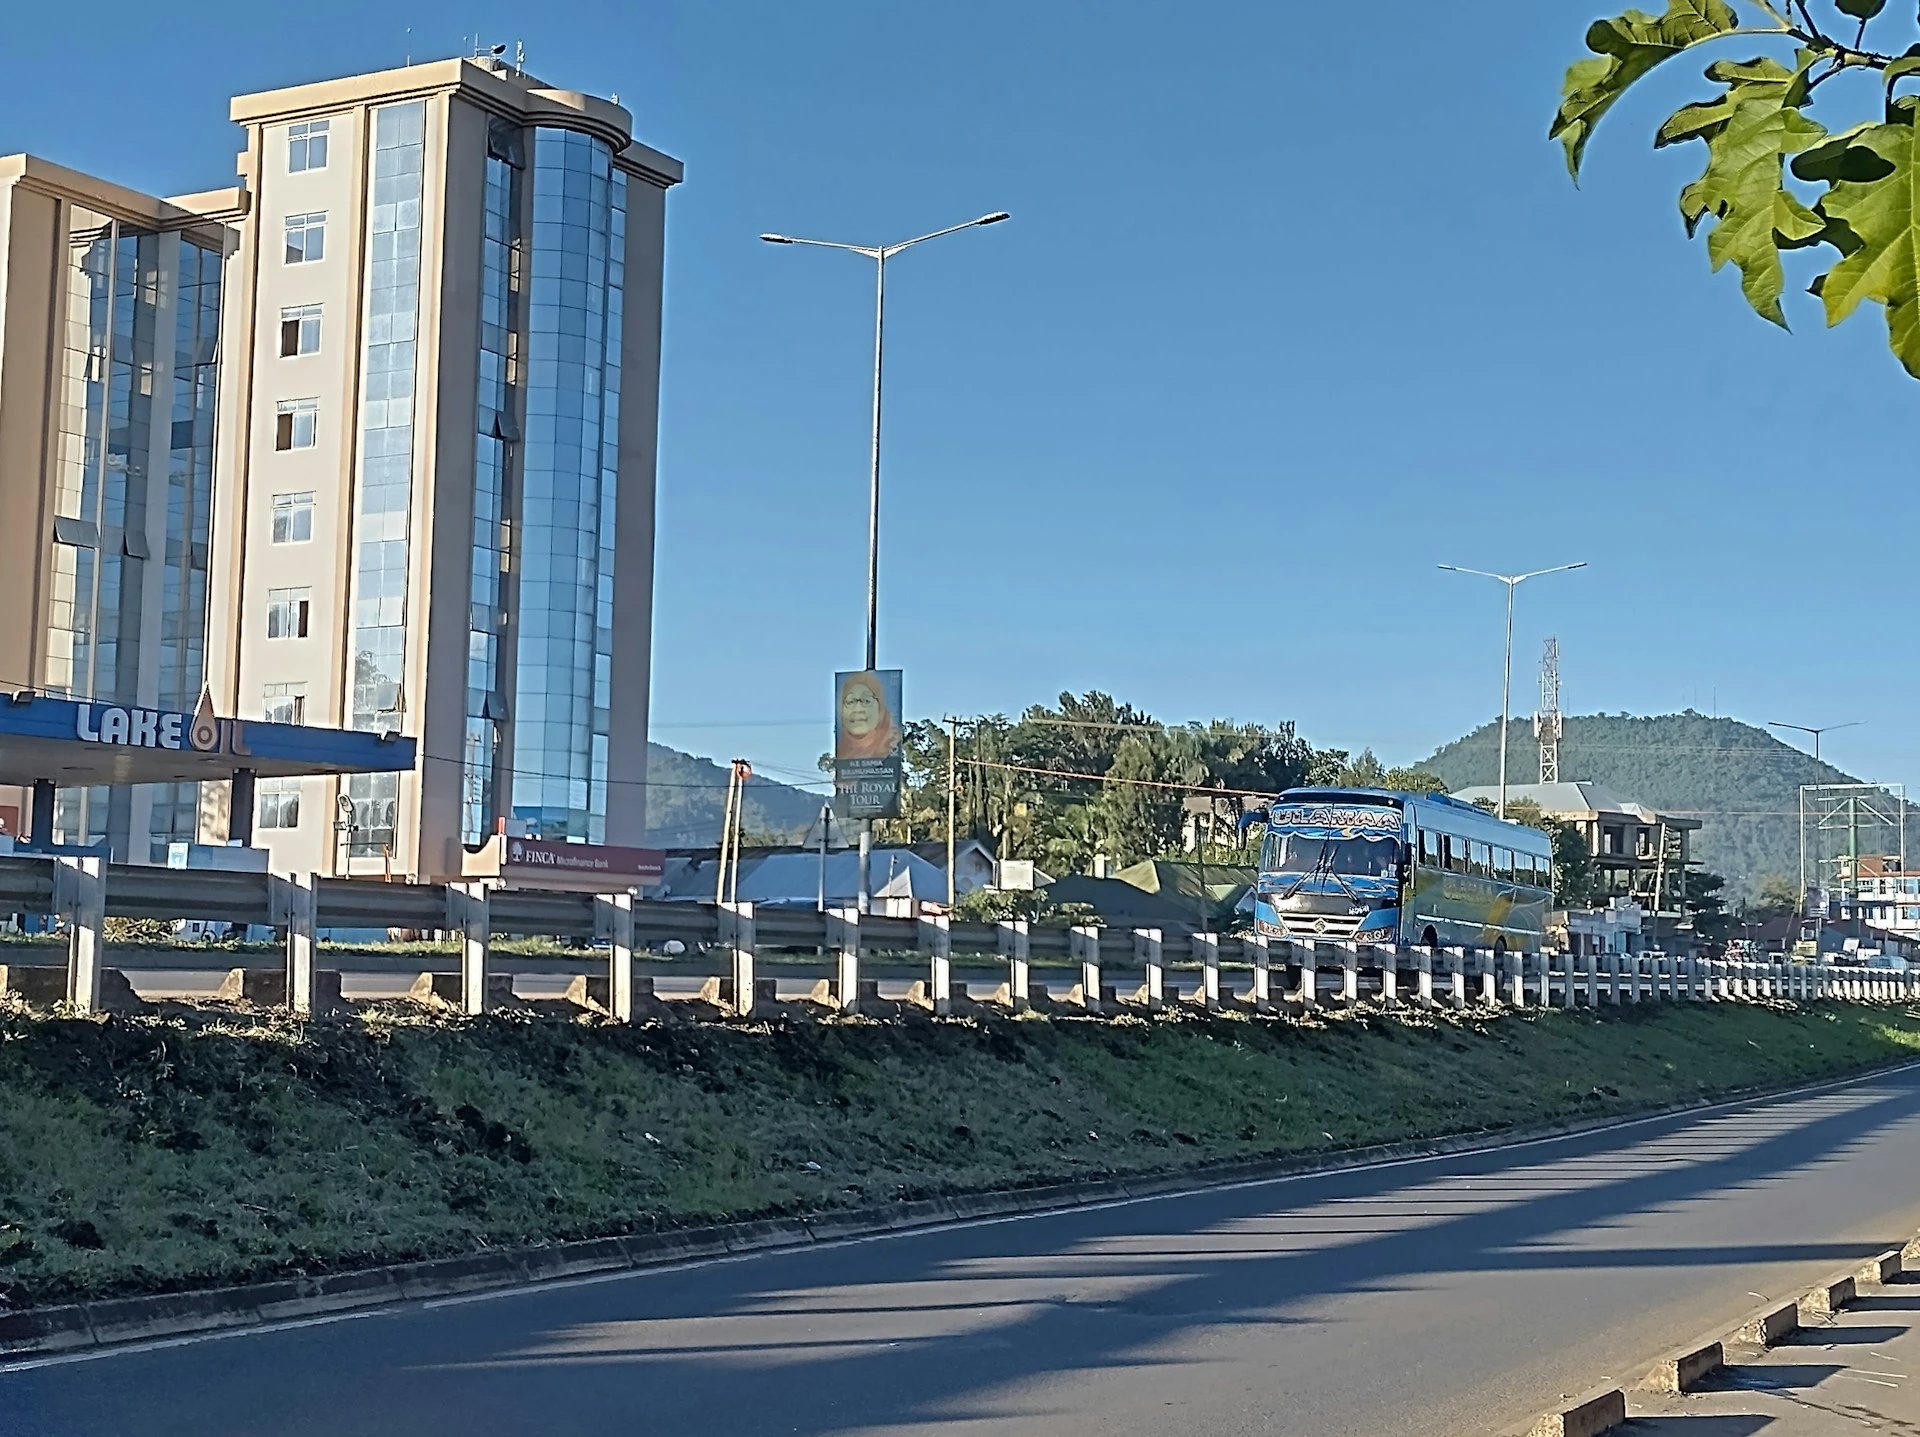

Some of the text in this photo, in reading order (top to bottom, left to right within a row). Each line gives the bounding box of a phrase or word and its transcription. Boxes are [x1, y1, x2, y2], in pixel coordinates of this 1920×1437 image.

[76, 682, 251, 756] LAKE OIL
[861, 782, 897, 793] ROYAL
[850, 795, 881, 805] TOUR
[525, 850, 556, 865] FINCA
[594, 858, 609, 869] Bank
